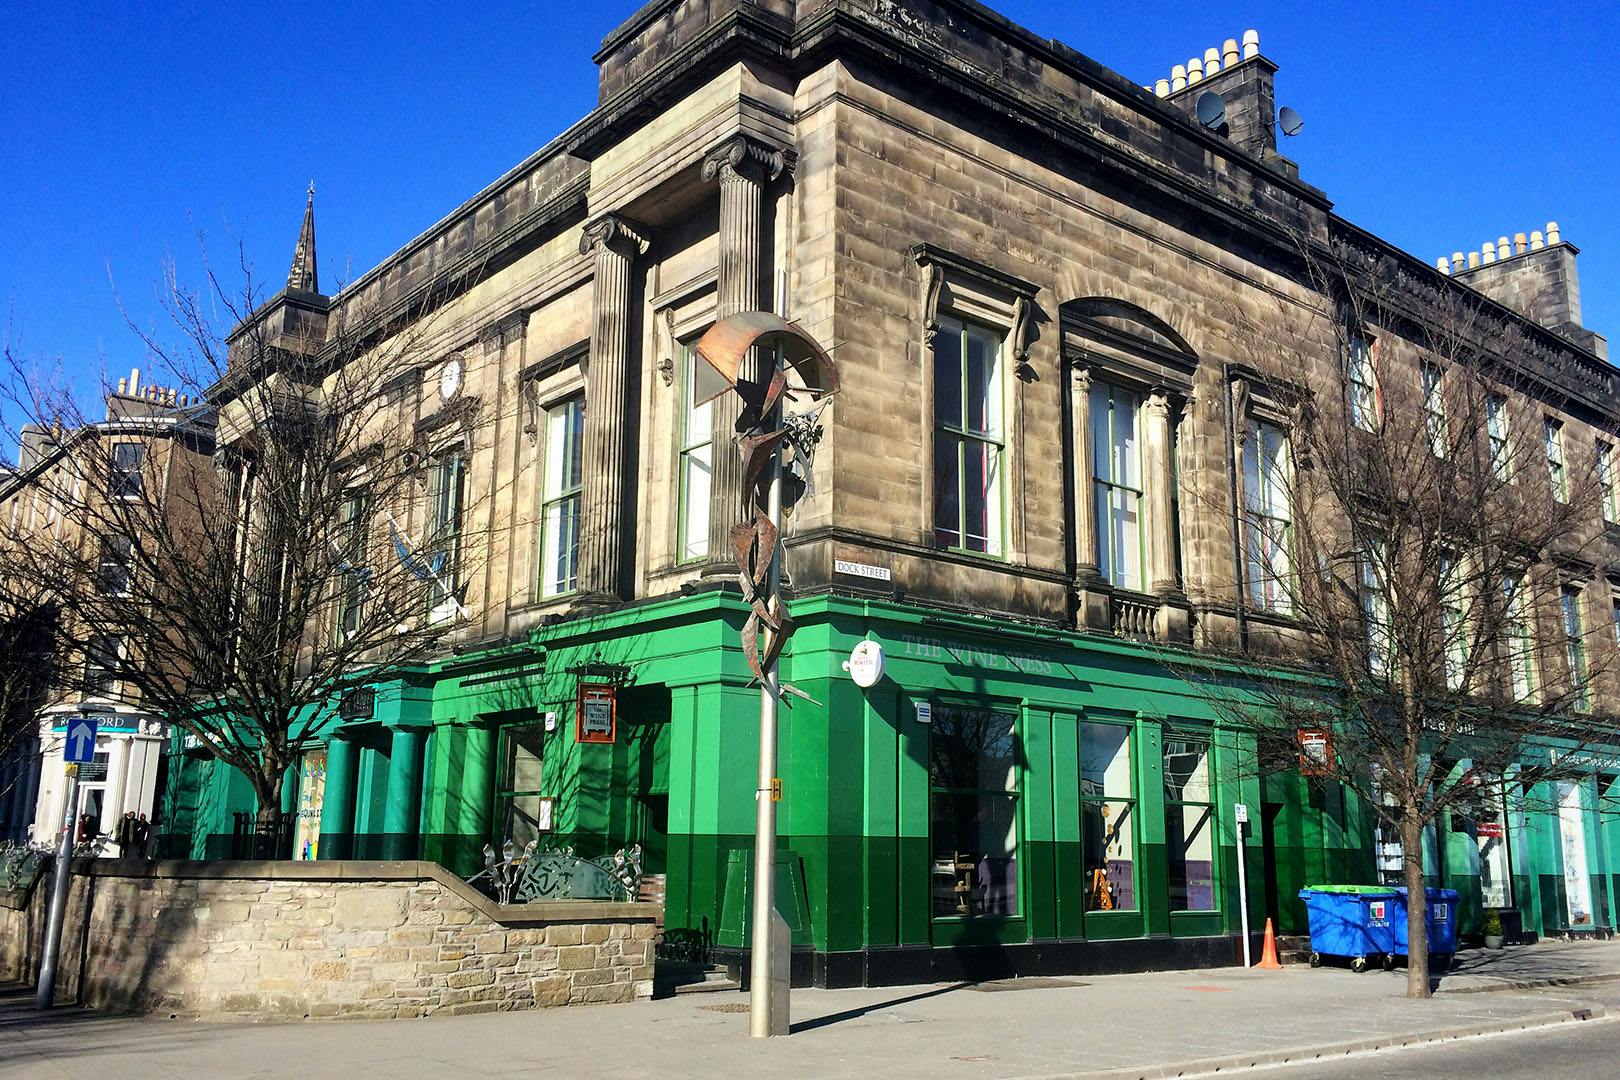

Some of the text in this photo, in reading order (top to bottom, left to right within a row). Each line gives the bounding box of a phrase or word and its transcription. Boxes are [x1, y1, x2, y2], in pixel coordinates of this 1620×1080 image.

[837, 562, 888, 579] DOCK STREET
[902, 634, 1052, 674] THE WINE PRESS
